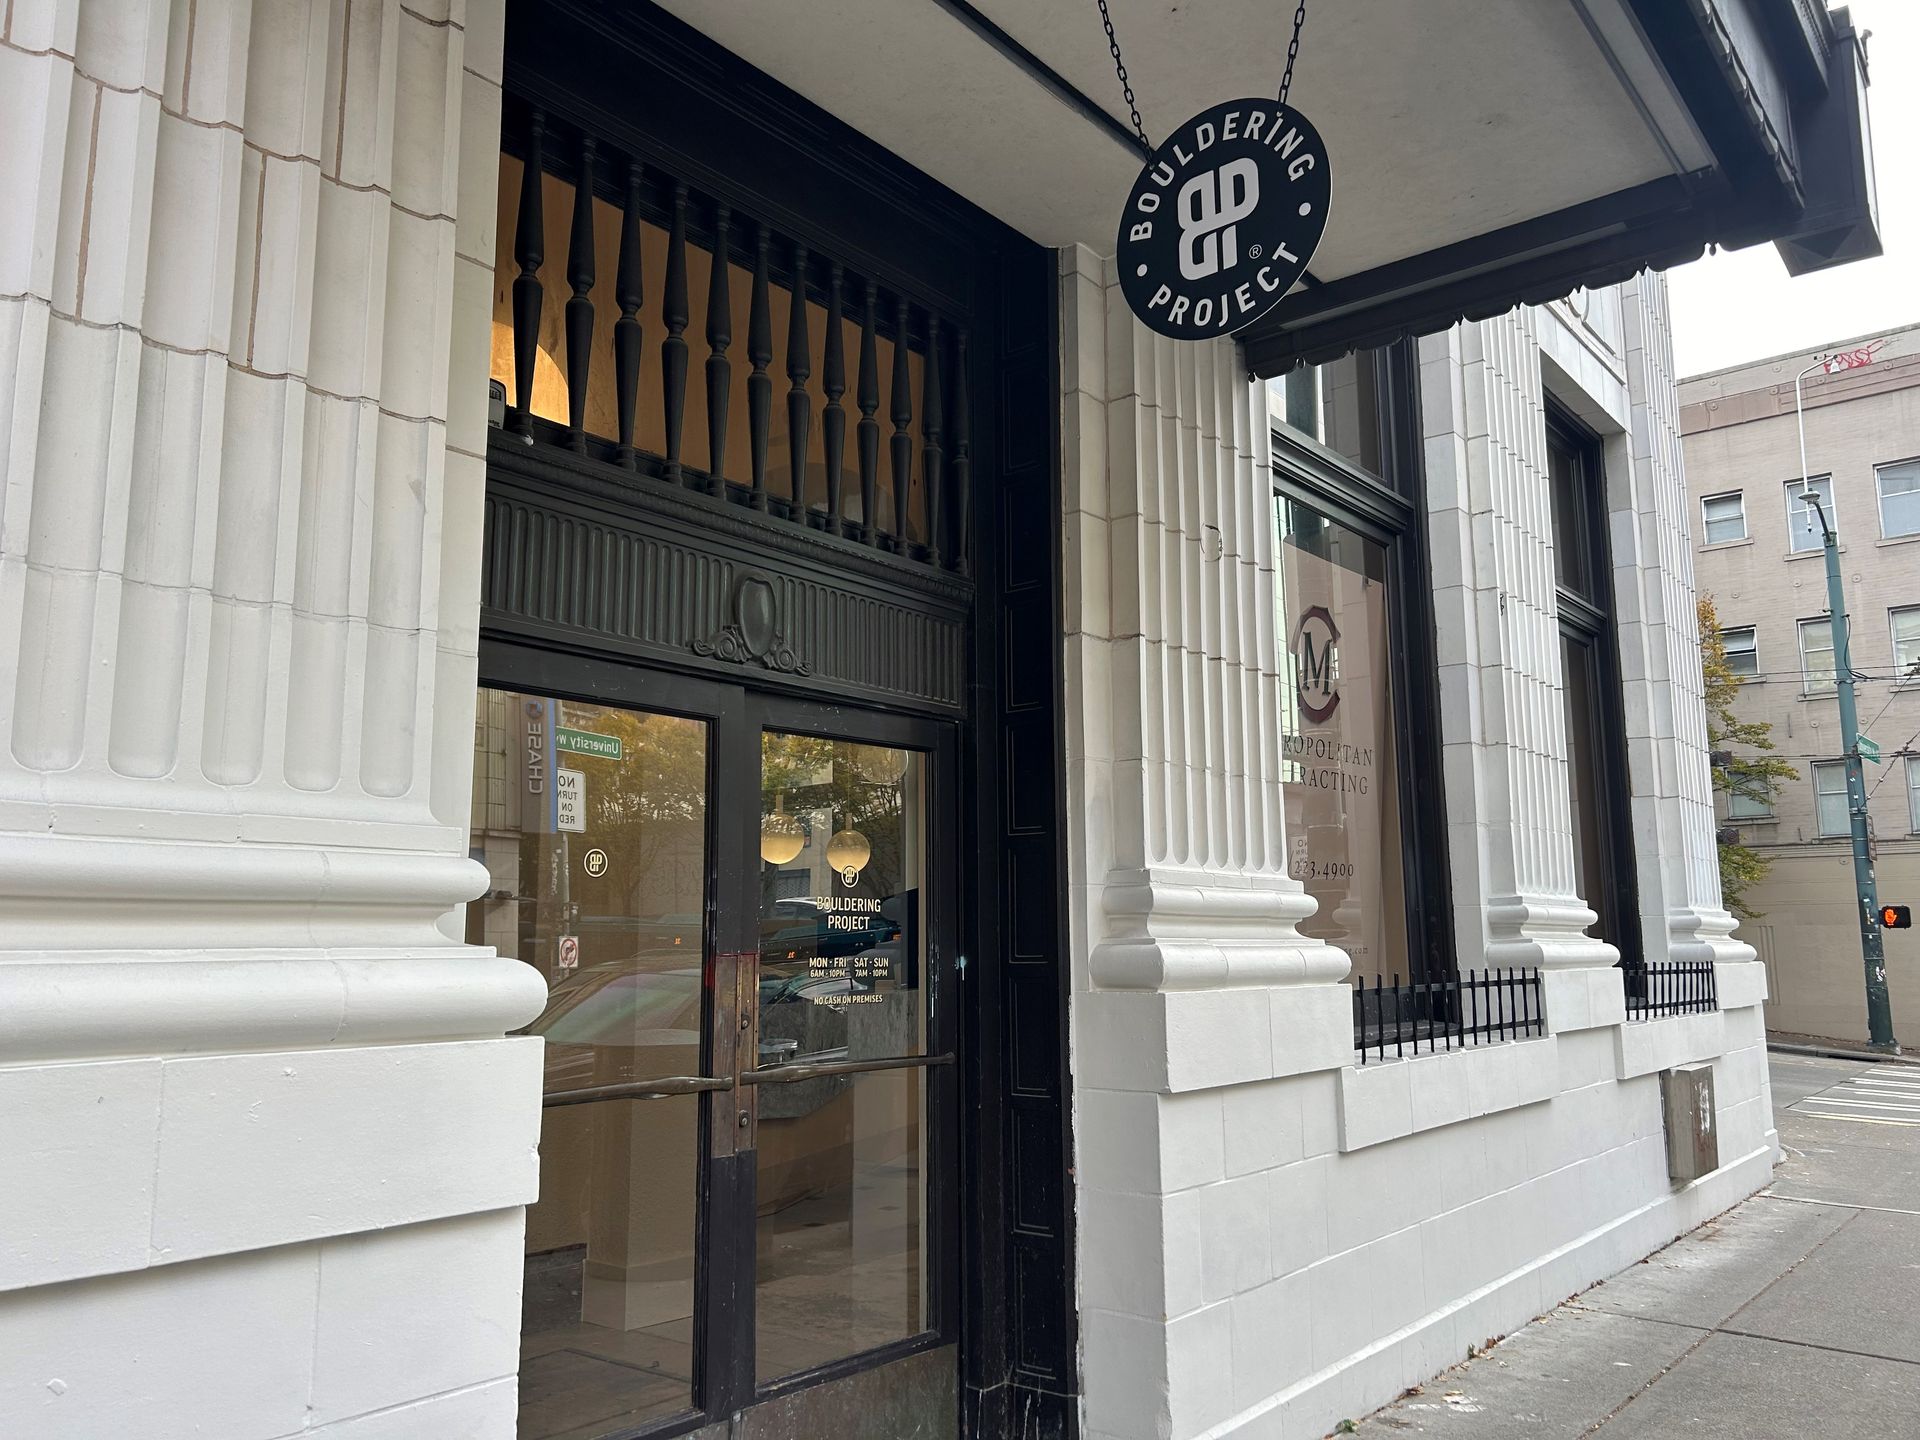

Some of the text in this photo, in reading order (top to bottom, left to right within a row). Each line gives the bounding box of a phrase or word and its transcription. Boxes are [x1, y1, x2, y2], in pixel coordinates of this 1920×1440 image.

[1129, 110, 1315, 242] BOULDERING
[1147, 241, 1299, 328] PROJECT
[1283, 735, 1372, 767] ROPOLITAN
[1299, 766, 1369, 795] RACTING
[816, 896, 881, 913] BOULDERING
[827, 915, 870, 932] PROJECT
[809, 957, 847, 968] MON FRI
[854, 957, 889, 968] SAT SUN
[813, 996, 823, 1005] NO
[842, 995, 851, 1004] ON
[852, 994, 883, 1004] PREMISES
